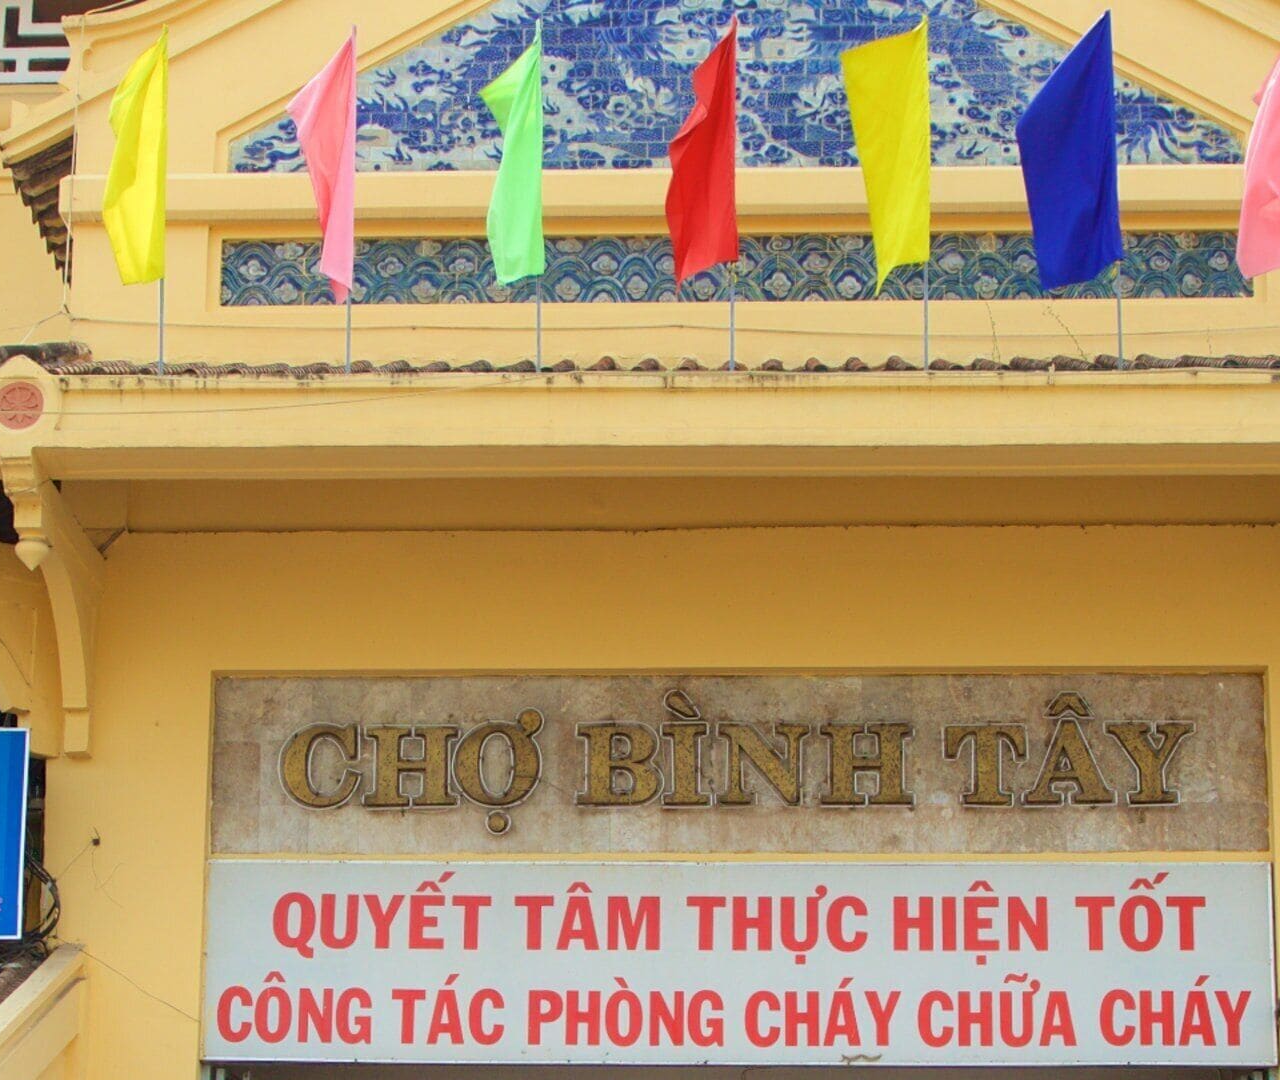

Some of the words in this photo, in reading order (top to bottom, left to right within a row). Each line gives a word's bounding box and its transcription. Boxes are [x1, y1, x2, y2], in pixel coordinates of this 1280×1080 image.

[279, 707, 542, 836] CHỢ
[578, 688, 915, 809] BÌNH
[943, 690, 1195, 808] TÂY
[273, 872, 491, 959] QUYẾT
[514, 881, 662, 953] TÂM
[687, 885, 869, 965] THỰC
[892, 881, 1049, 965] HIỆN
[1074, 873, 1206, 954] TỐT
[217, 971, 372, 1045] CÔNG
[390, 973, 505, 1045] TÁC
[526, 977, 724, 1047] PHÒNG
[744, 977, 898, 1049] CHÁY
[917, 974, 1077, 1049] CHỮA
[1099, 974, 1250, 1049] CHÁY
